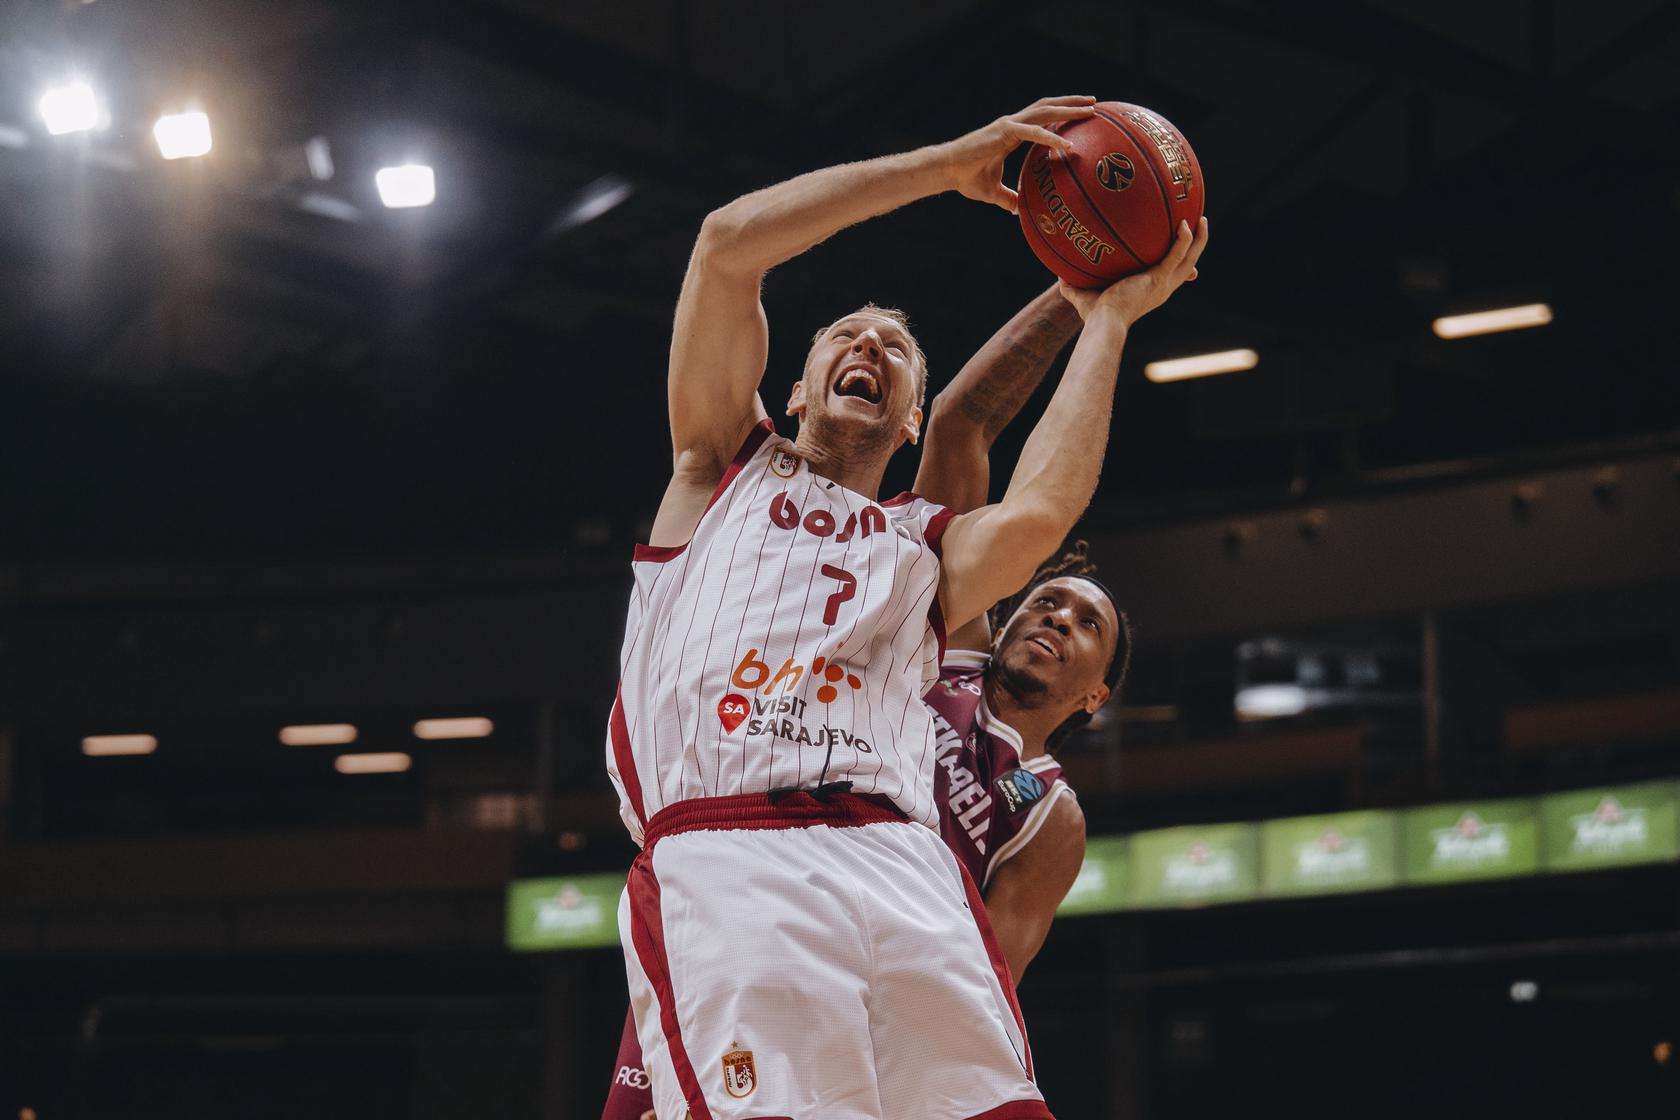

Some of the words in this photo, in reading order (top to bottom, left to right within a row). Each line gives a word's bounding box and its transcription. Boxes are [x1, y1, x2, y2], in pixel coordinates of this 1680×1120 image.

[769, 491, 886, 543] bosn
[821, 563, 857, 626] 7
[723, 701, 745, 715] SA
[753, 696, 807, 719] VISIT
[747, 719, 872, 753] SARAJEVO
